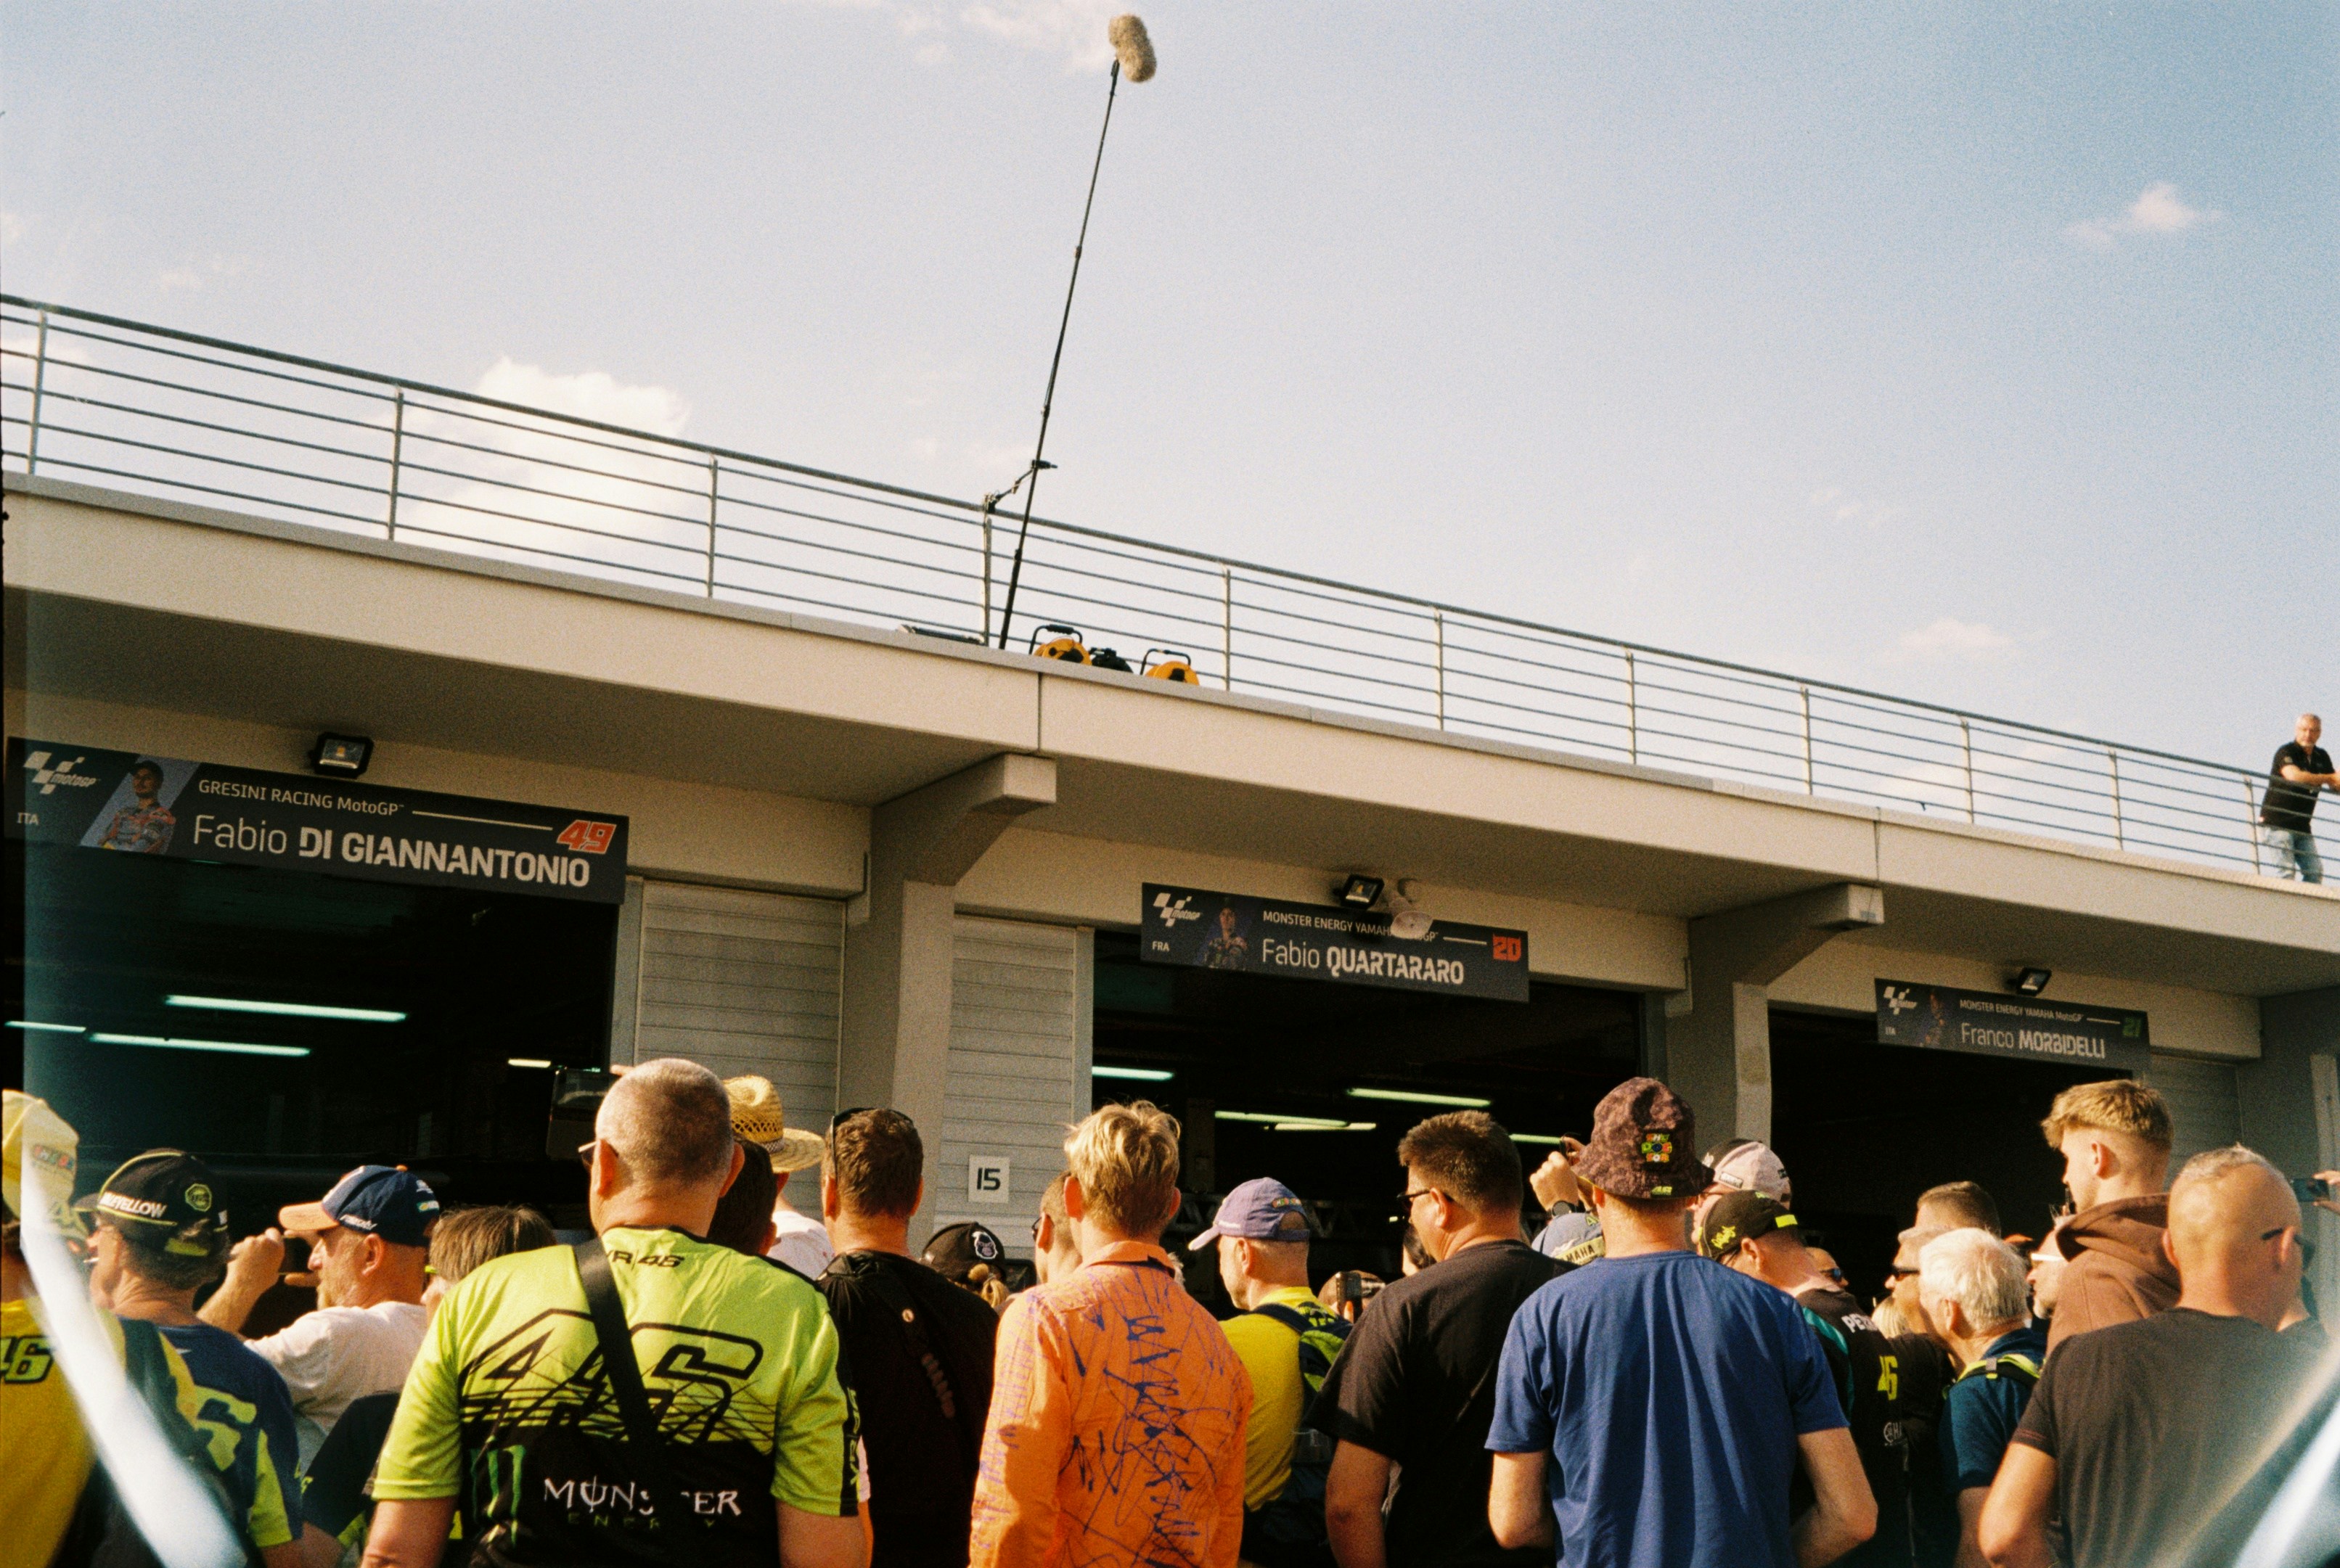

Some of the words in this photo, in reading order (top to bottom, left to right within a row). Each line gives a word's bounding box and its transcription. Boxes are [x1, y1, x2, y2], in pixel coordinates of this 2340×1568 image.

[198, 779, 267, 800] GRESINI
[271, 788, 332, 808] RACING
[17, 812, 39, 825] ITA
[193, 814, 287, 854] Fabio
[299, 826, 332, 859] DI
[342, 832, 589, 887] GIANNANTONIO
[556, 819, 617, 855] 49
[1263, 911, 1312, 927] MONSTER
[1314, 917, 1353, 932] ENERGY
[1355, 922, 1392, 937] YAMAH
[1152, 941, 1169, 951] FRA
[1493, 933, 1522, 962] 20
[1262, 938, 1320, 969] Fabio
[1326, 945, 1465, 985] QUARTARARO
[1960, 999, 1995, 1012] MONSTER
[2025, 1006, 2055, 1019] YAMAHA
[1961, 1022, 2015, 1048] Franco
[2018, 1029, 2106, 1059] MORBIDELLI
[976, 1167, 1001, 1190] 15
[544, 1475, 742, 1516] MONSER
